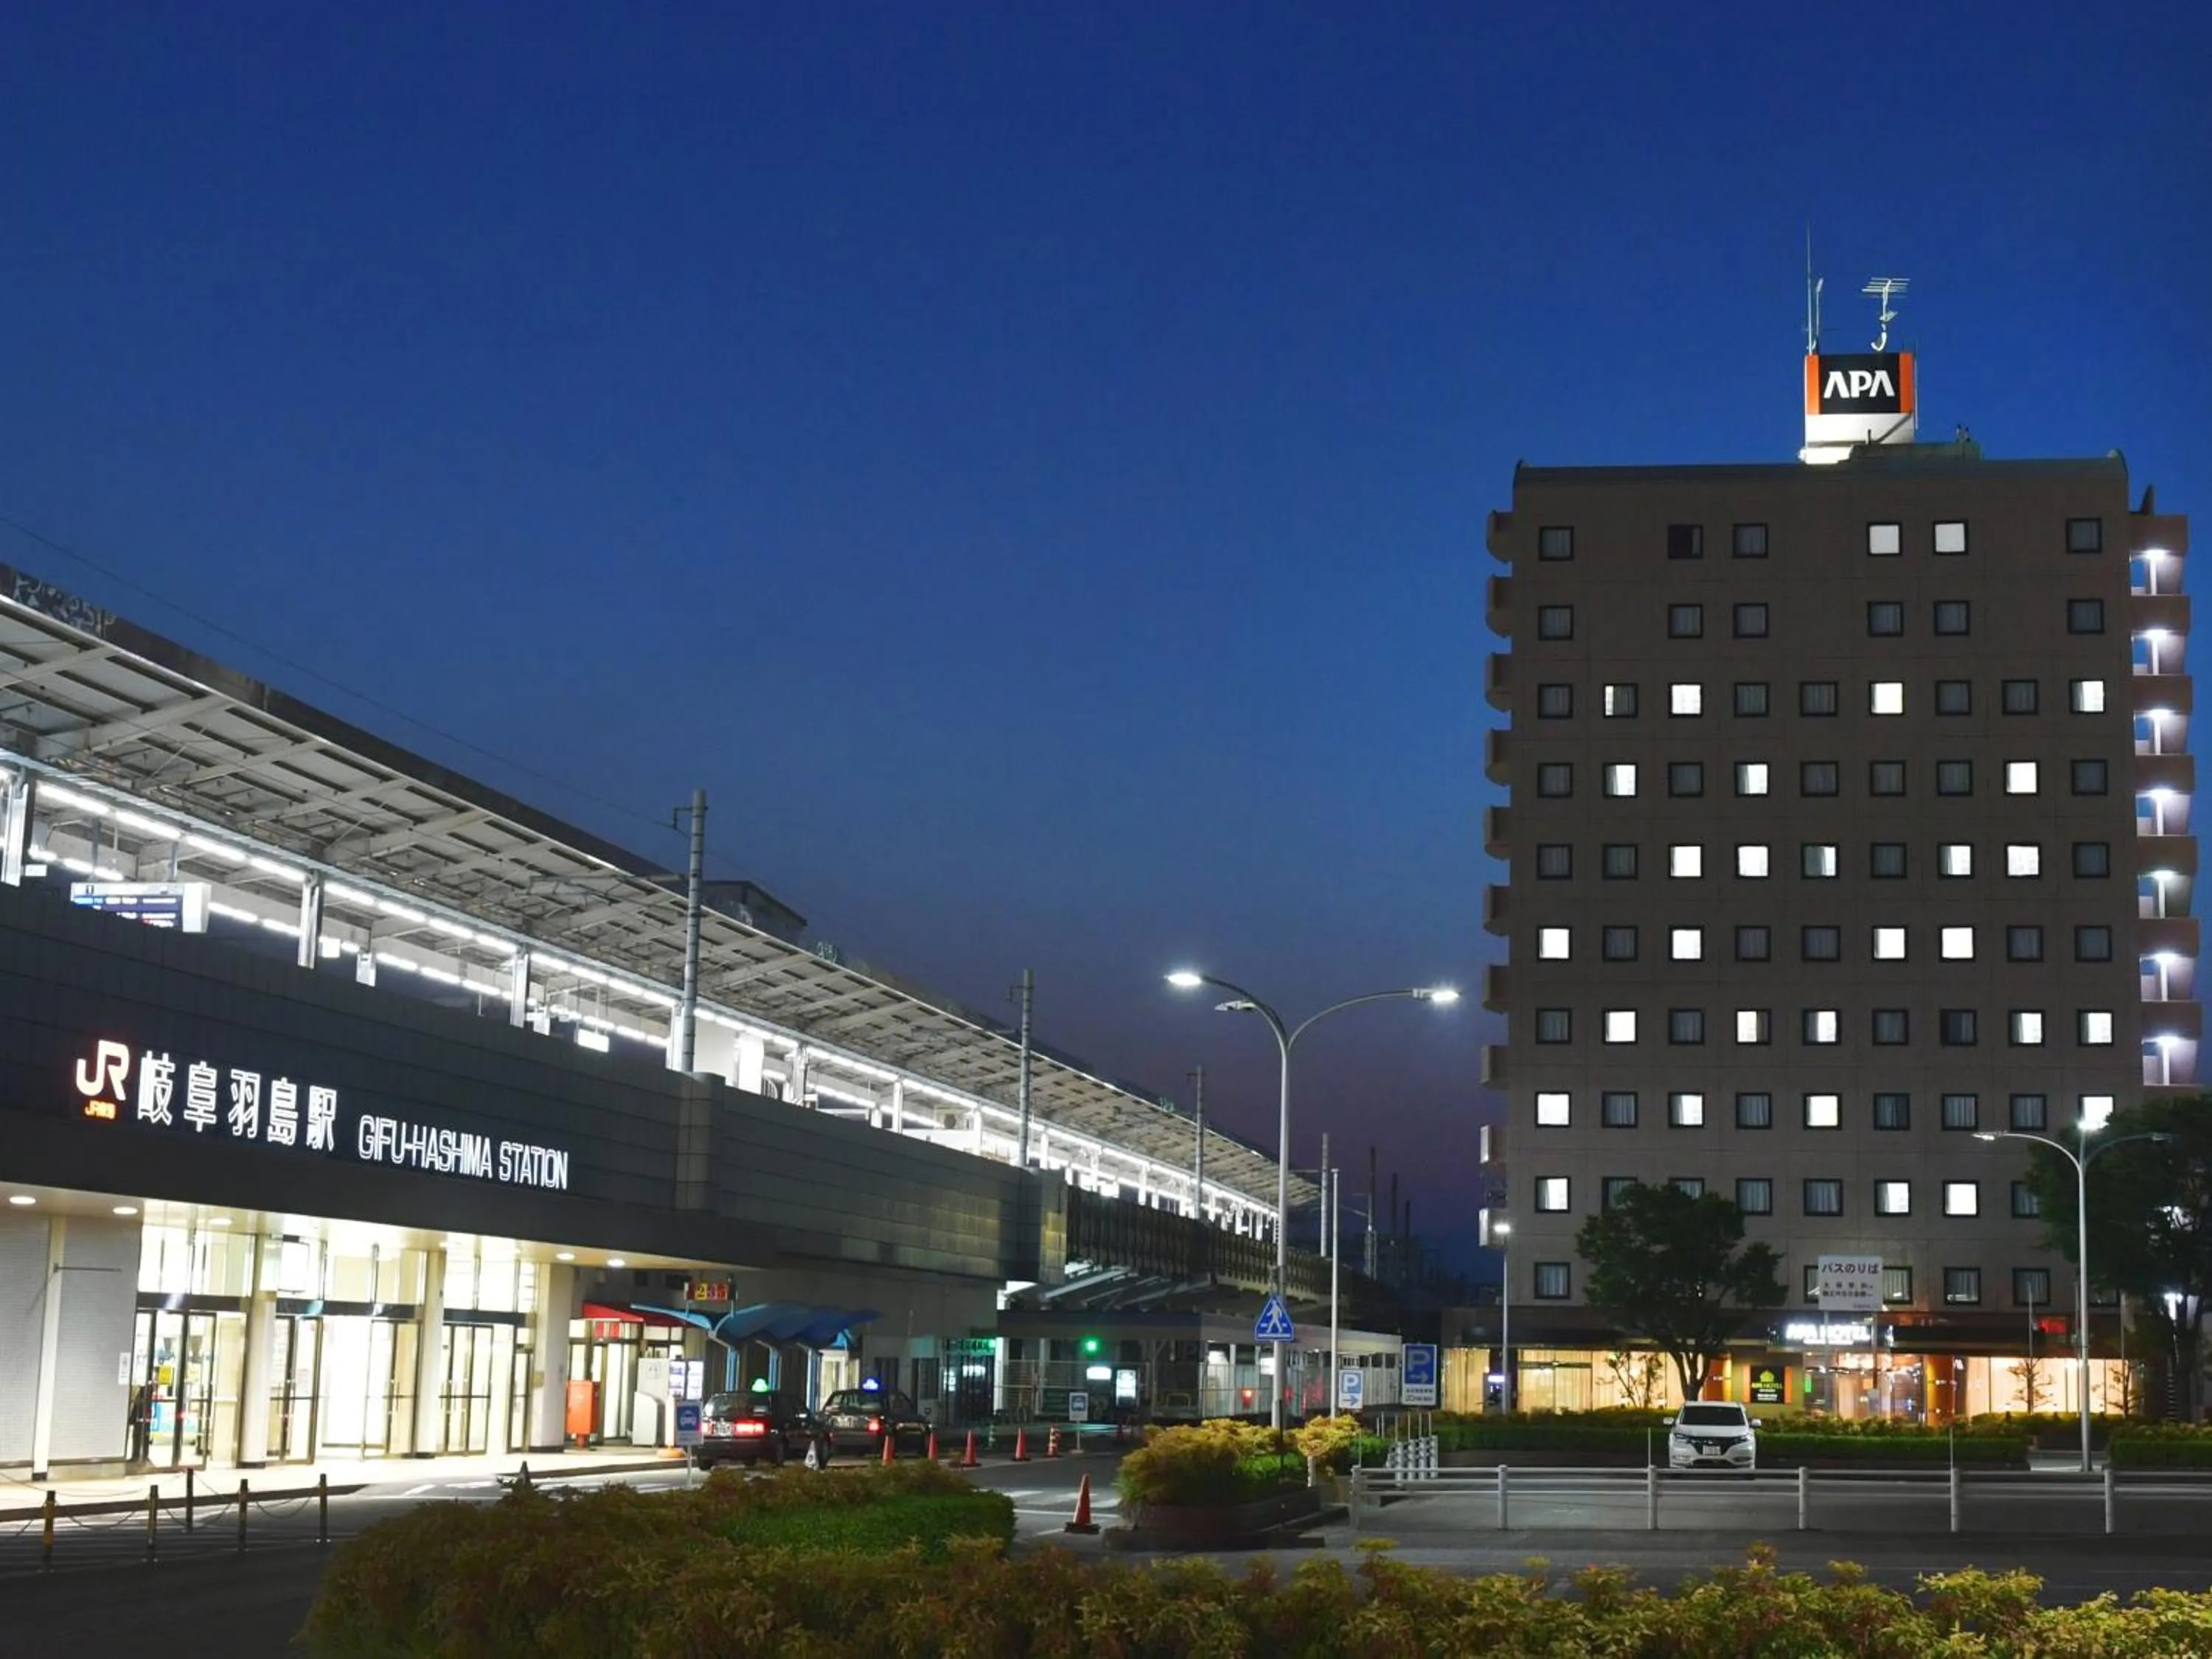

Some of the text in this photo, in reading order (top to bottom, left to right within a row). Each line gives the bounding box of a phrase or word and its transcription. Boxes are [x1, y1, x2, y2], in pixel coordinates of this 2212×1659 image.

[1823, 369, 1896, 399] APA
[76, 1039, 130, 1101] JR
[137, 1050, 337, 1152] 岐阜羽島駅
[358, 1114, 568, 1190] GIFU-HASHIMA STATION
[1821, 1262, 1879, 1275] バスのりば
[1408, 1350, 1430, 1372] P
[1343, 1374, 1358, 1394] P
